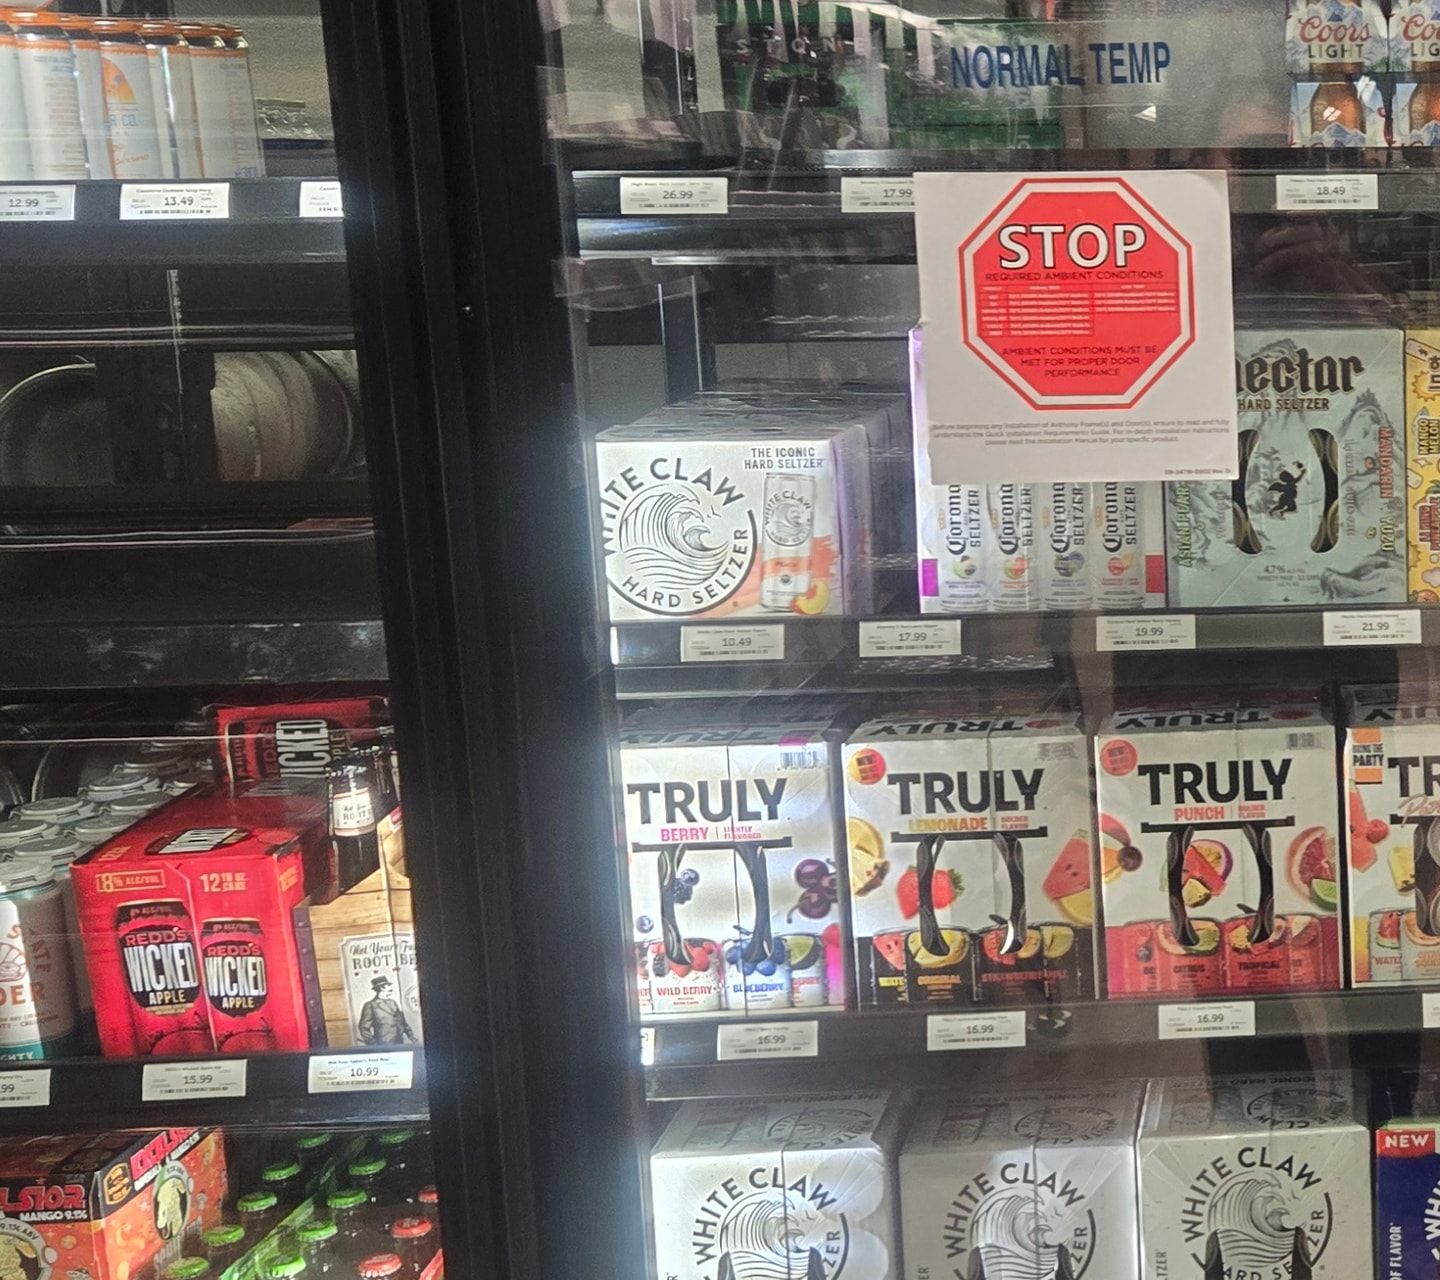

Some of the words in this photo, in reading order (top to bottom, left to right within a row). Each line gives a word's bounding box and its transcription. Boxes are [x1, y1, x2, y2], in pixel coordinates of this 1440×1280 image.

[1299, 17, 1373, 45] Coors
[1307, 43, 1364, 61] LIGHT
[950, 43, 1084, 90] NORMAL
[1089, 41, 1171, 86] TEMP
[662, 190, 694, 200] 26.99
[1315, 186, 1346, 196] 18.49
[8, 198, 40, 208] 12.99
[164, 196, 194, 207] 13.49
[997, 222, 1148, 270] STOP
[985, 271, 1041, 281] REQUIRED
[1045, 271, 1093, 281] AMBIENT
[1096, 270, 1164, 280] CONDITIONS
[1050, 345, 1112, 355] CONDITIONS
[1115, 345, 1142, 354] MUST
[1068, 357, 1108, 366] PROPER
[1111, 356, 1140, 365] DOOR
[1045, 368, 1120, 378] PERFORMANCE
[751, 447, 772, 459] THE
[775, 446, 816, 458] ICONIC
[744, 458, 774, 470] HARD
[777, 458, 824, 470] SELTZER
[1379, 426, 1394, 499] MANDARIN
[649, 457, 745, 506] CLAW
[969, 489, 982, 548] SELTZER
[1381, 516, 1394, 551] YUZU
[622, 573, 682, 609] HARD
[692, 527, 748, 605] SELTZER
[1135, 626, 1164, 637] 19.99
[1361, 621, 1390, 632] 21.99
[1138, 757, 1293, 806] TRULY
[887, 768, 1045, 816] TRULY
[627, 778, 787, 825] TRULY
[1174, 807, 1225, 821] PUNCH
[908, 817, 988, 832] LEMONADE
[660, 827, 709, 842] BERRY
[201, 874, 221, 892] 12
[125, 929, 188, 945] REDD'S
[123, 942, 200, 992] WICKED
[352, 955, 392, 971] ROOT
[149, 990, 187, 1004] APPLE
[656, 986, 680, 997] WILD
[683, 985, 713, 997] BERRY
[183, 1074, 214, 1085] 15.99
[350, 1066, 379, 1078] 10.99
[1384, 1132, 1430, 1149] NEW
[20, 1211, 62, 1221] MANGO
[943, 1172, 995, 1258] WHITE
[999, 1163, 1085, 1207] CLAW
